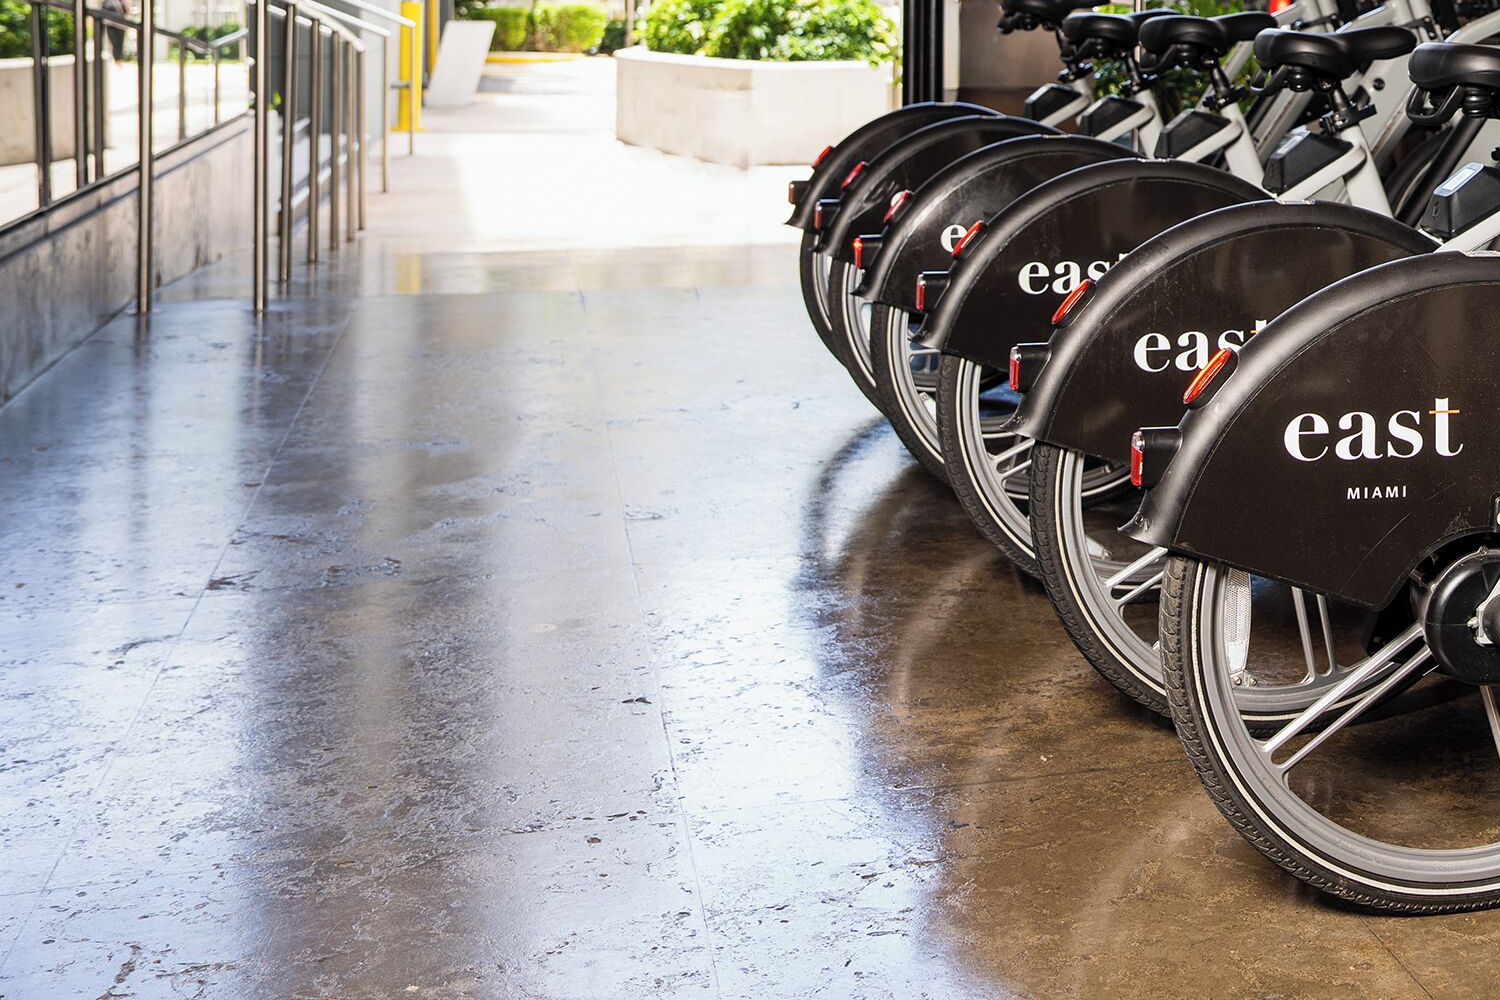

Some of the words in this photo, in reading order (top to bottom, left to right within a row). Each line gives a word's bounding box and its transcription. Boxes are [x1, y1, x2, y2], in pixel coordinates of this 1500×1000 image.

[1018, 252, 1131, 295] eas
[1133, 319, 1267, 373] eas
[1283, 397, 1464, 462] east
[1346, 485, 1407, 500] MIAMI
